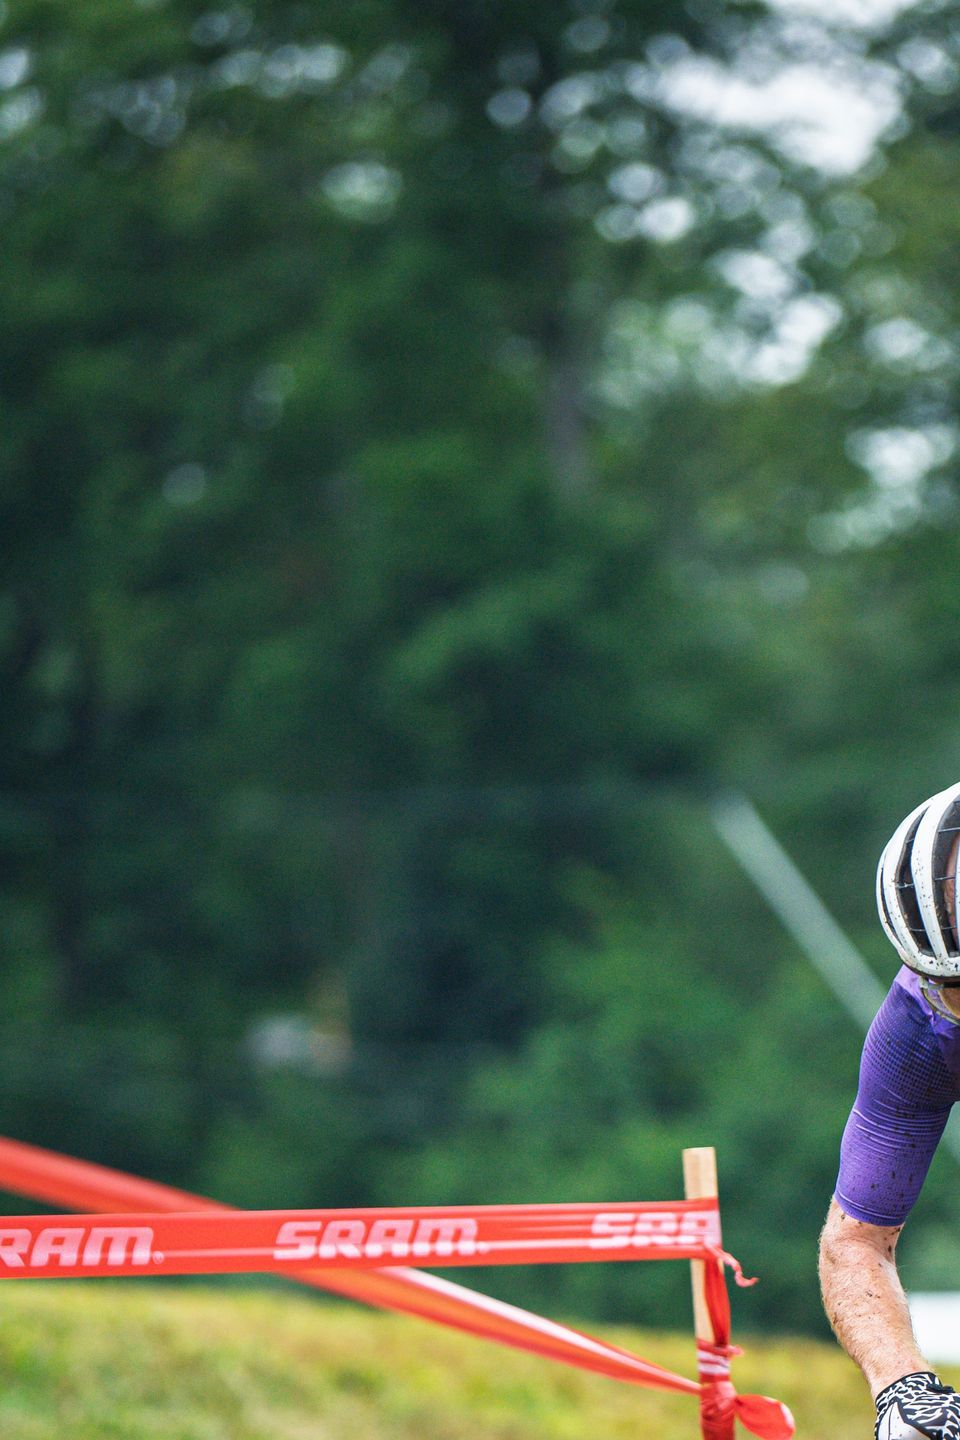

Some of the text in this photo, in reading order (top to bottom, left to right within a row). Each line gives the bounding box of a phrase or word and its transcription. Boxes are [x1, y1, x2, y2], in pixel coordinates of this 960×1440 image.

[0, 1210, 722, 1268] RAM SRAM SRA
